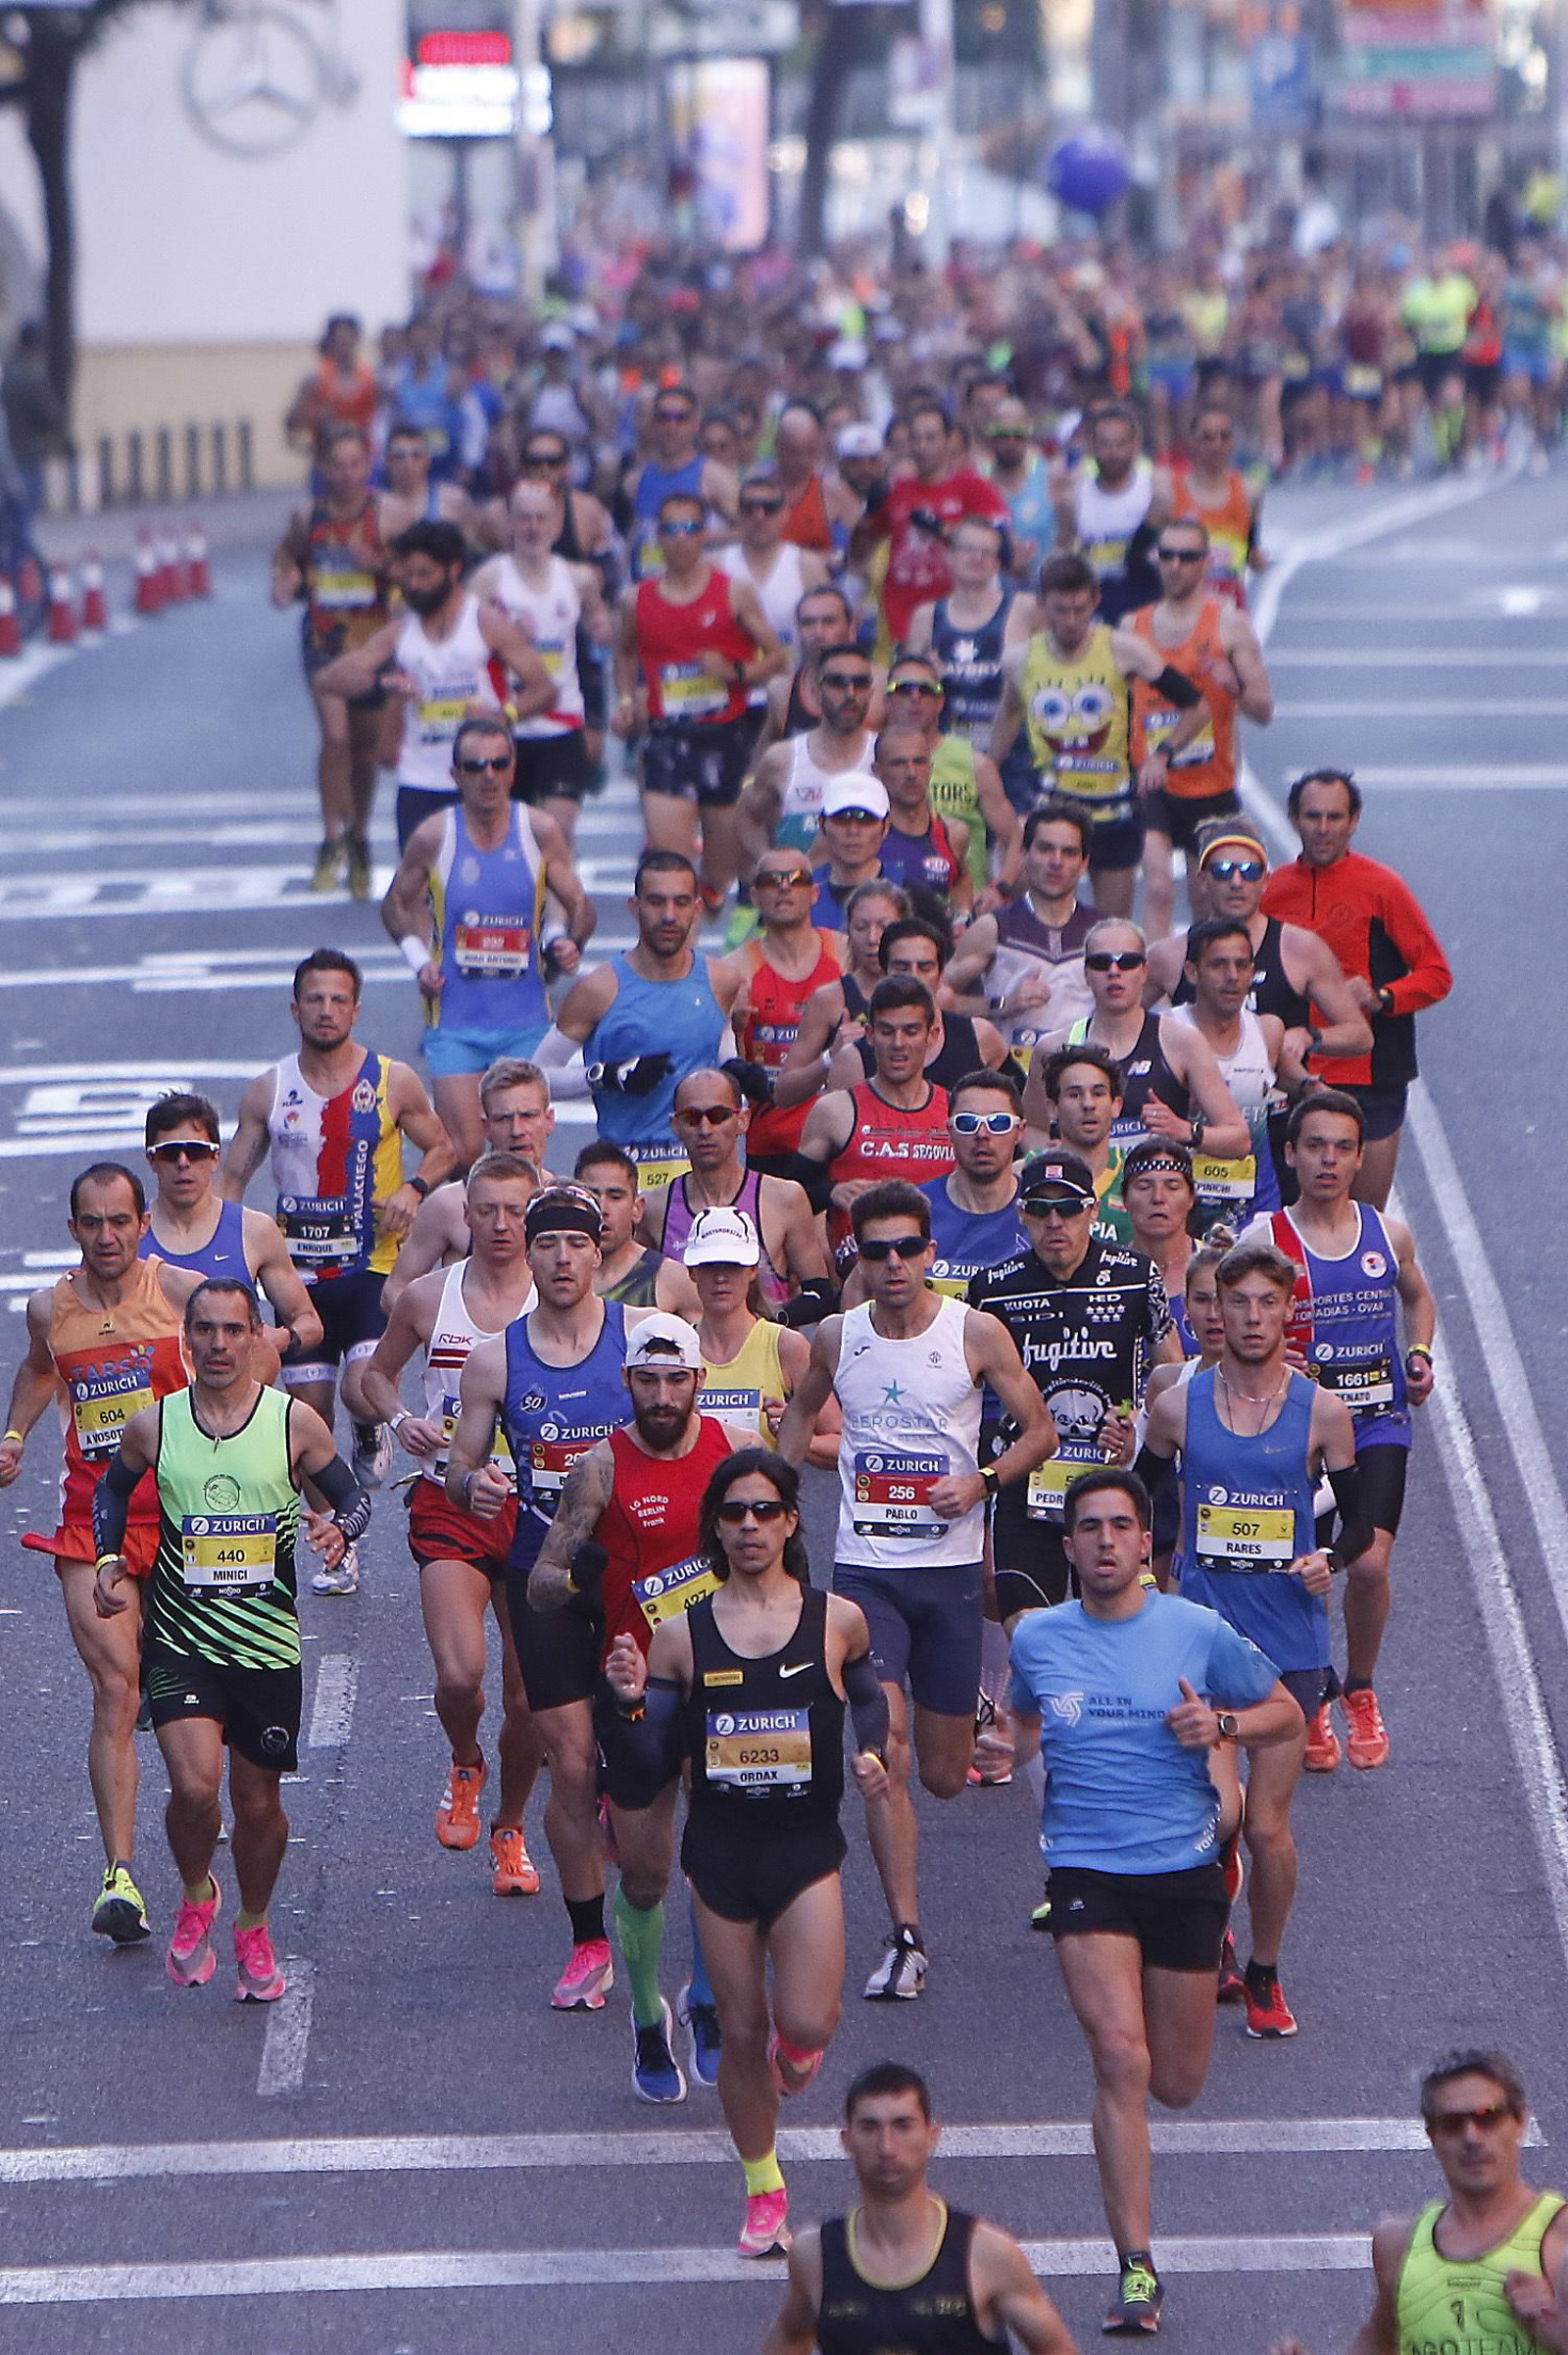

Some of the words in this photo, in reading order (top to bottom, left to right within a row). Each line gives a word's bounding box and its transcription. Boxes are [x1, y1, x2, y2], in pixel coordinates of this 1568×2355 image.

[1204, 1165, 1229, 1178] 605
[353, 1139, 368, 1230] PALACIEGO
[647, 1174, 669, 1186] 527
[300, 1199, 344, 1211] ZURICH
[301, 1226, 330, 1239] 1707
[1100, 1249, 1138, 1267] fugitive
[987, 1260, 1026, 1285] fugitive
[1089, 1294, 1122, 1302] HED
[1004, 1299, 1051, 1312] KUOTA
[1023, 1326, 1117, 1372] fugitive
[1336, 1343, 1384, 1359] ZURICH
[90, 1375, 138, 1397] ZURICH
[1336, 1372, 1369, 1387] 1661
[697, 1394, 750, 1405] ZURICH
[100, 1408, 125, 1424] 604
[562, 1425, 614, 1440] ZURICH
[887, 1458, 939, 1472] ZURICH
[888, 1486, 915, 1500] 256
[1231, 1492, 1284, 1506] ZURICH
[642, 1495, 668, 1506] NORD
[637, 1505, 665, 1518] BERLIN
[886, 1507, 918, 1520] PABLO
[213, 1519, 266, 1533] ZURICH
[642, 1517, 665, 1528] Frank
[1232, 1522, 1260, 1537] 507
[1226, 1542, 1262, 1554] RARES
[217, 1549, 245, 1563] 440
[213, 1570, 248, 1582] MINICI
[1089, 1697, 1114, 1706] ALL
[1118, 1697, 1133, 1706] IN
[1089, 1708, 1125, 1718] YOUR
[738, 1716, 796, 1732] ZURICH
[740, 1749, 779, 1764] 6233
[740, 1771, 778, 1784] ORDAX
